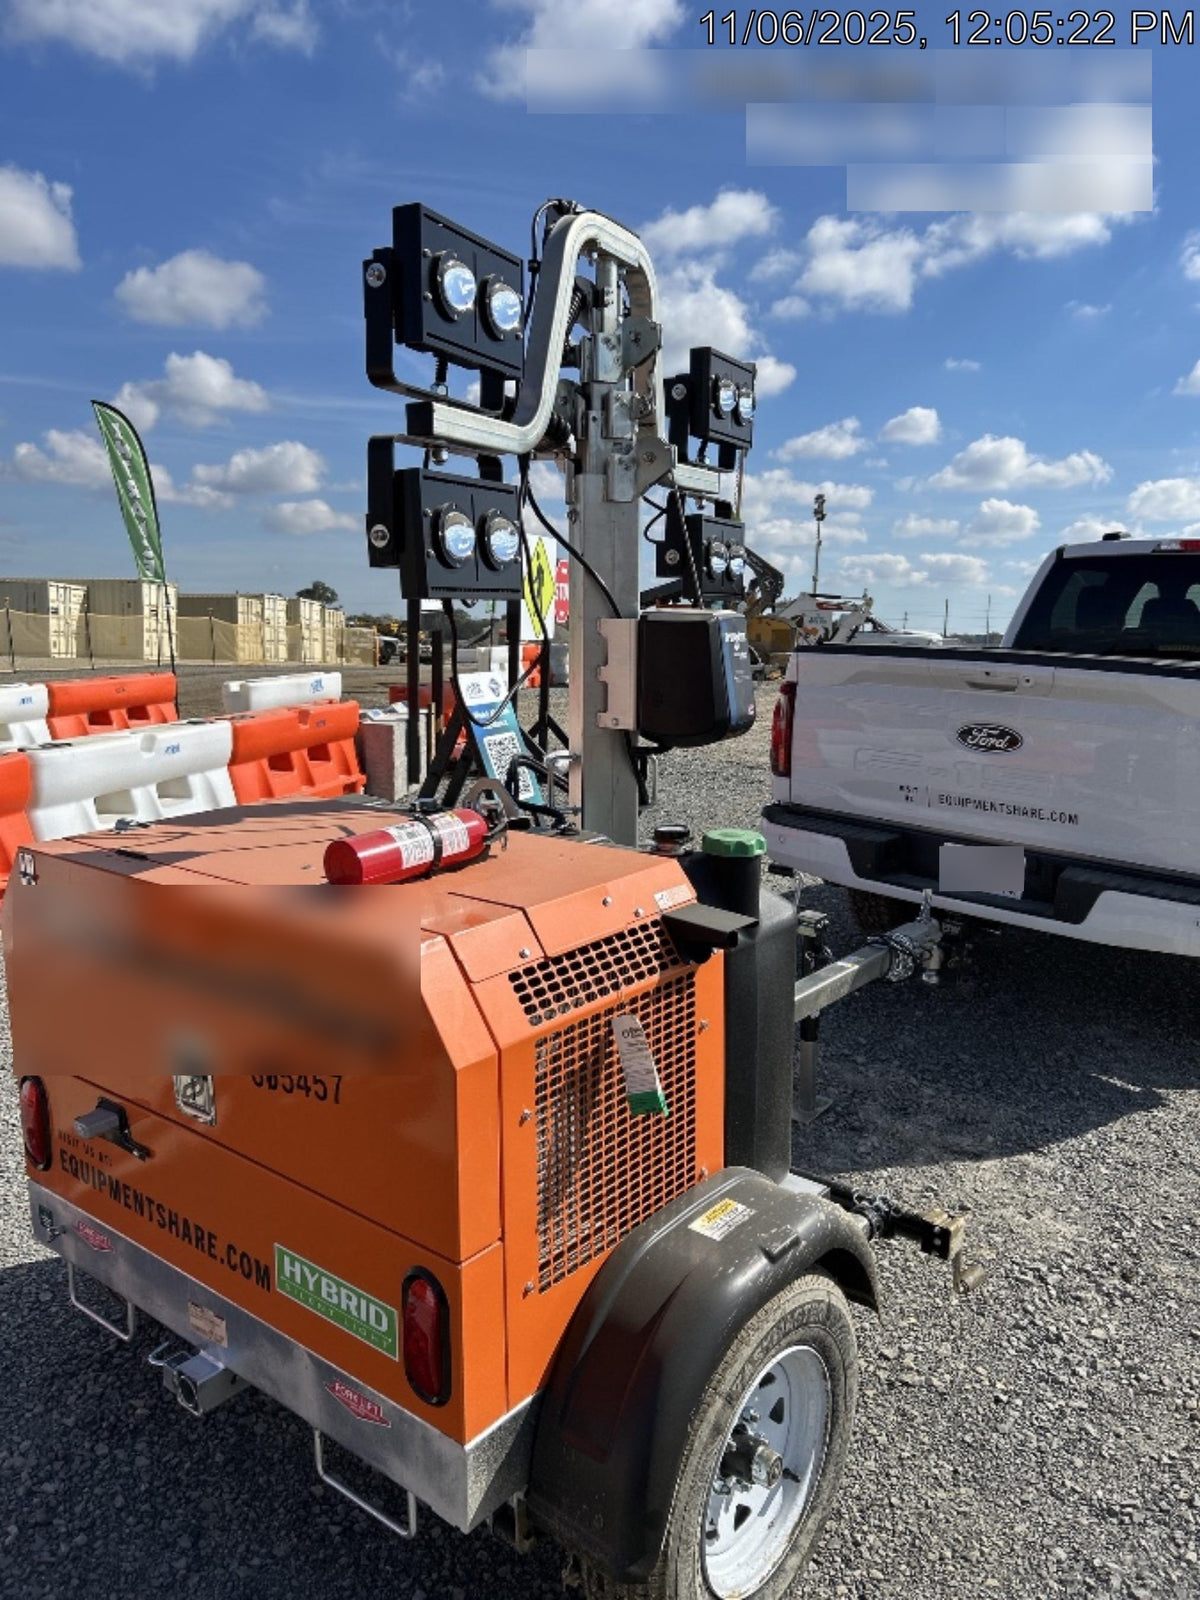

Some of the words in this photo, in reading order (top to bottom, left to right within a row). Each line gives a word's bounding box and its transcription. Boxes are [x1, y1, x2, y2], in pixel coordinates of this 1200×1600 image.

[966, 728, 1011, 749] Ford
[938, 794, 1079, 826] EQUIPMENTSHARE.COM
[59, 1147, 272, 1293] EQUIPMENTSHARE.COM
[283, 1254, 389, 1333] HYBRID
